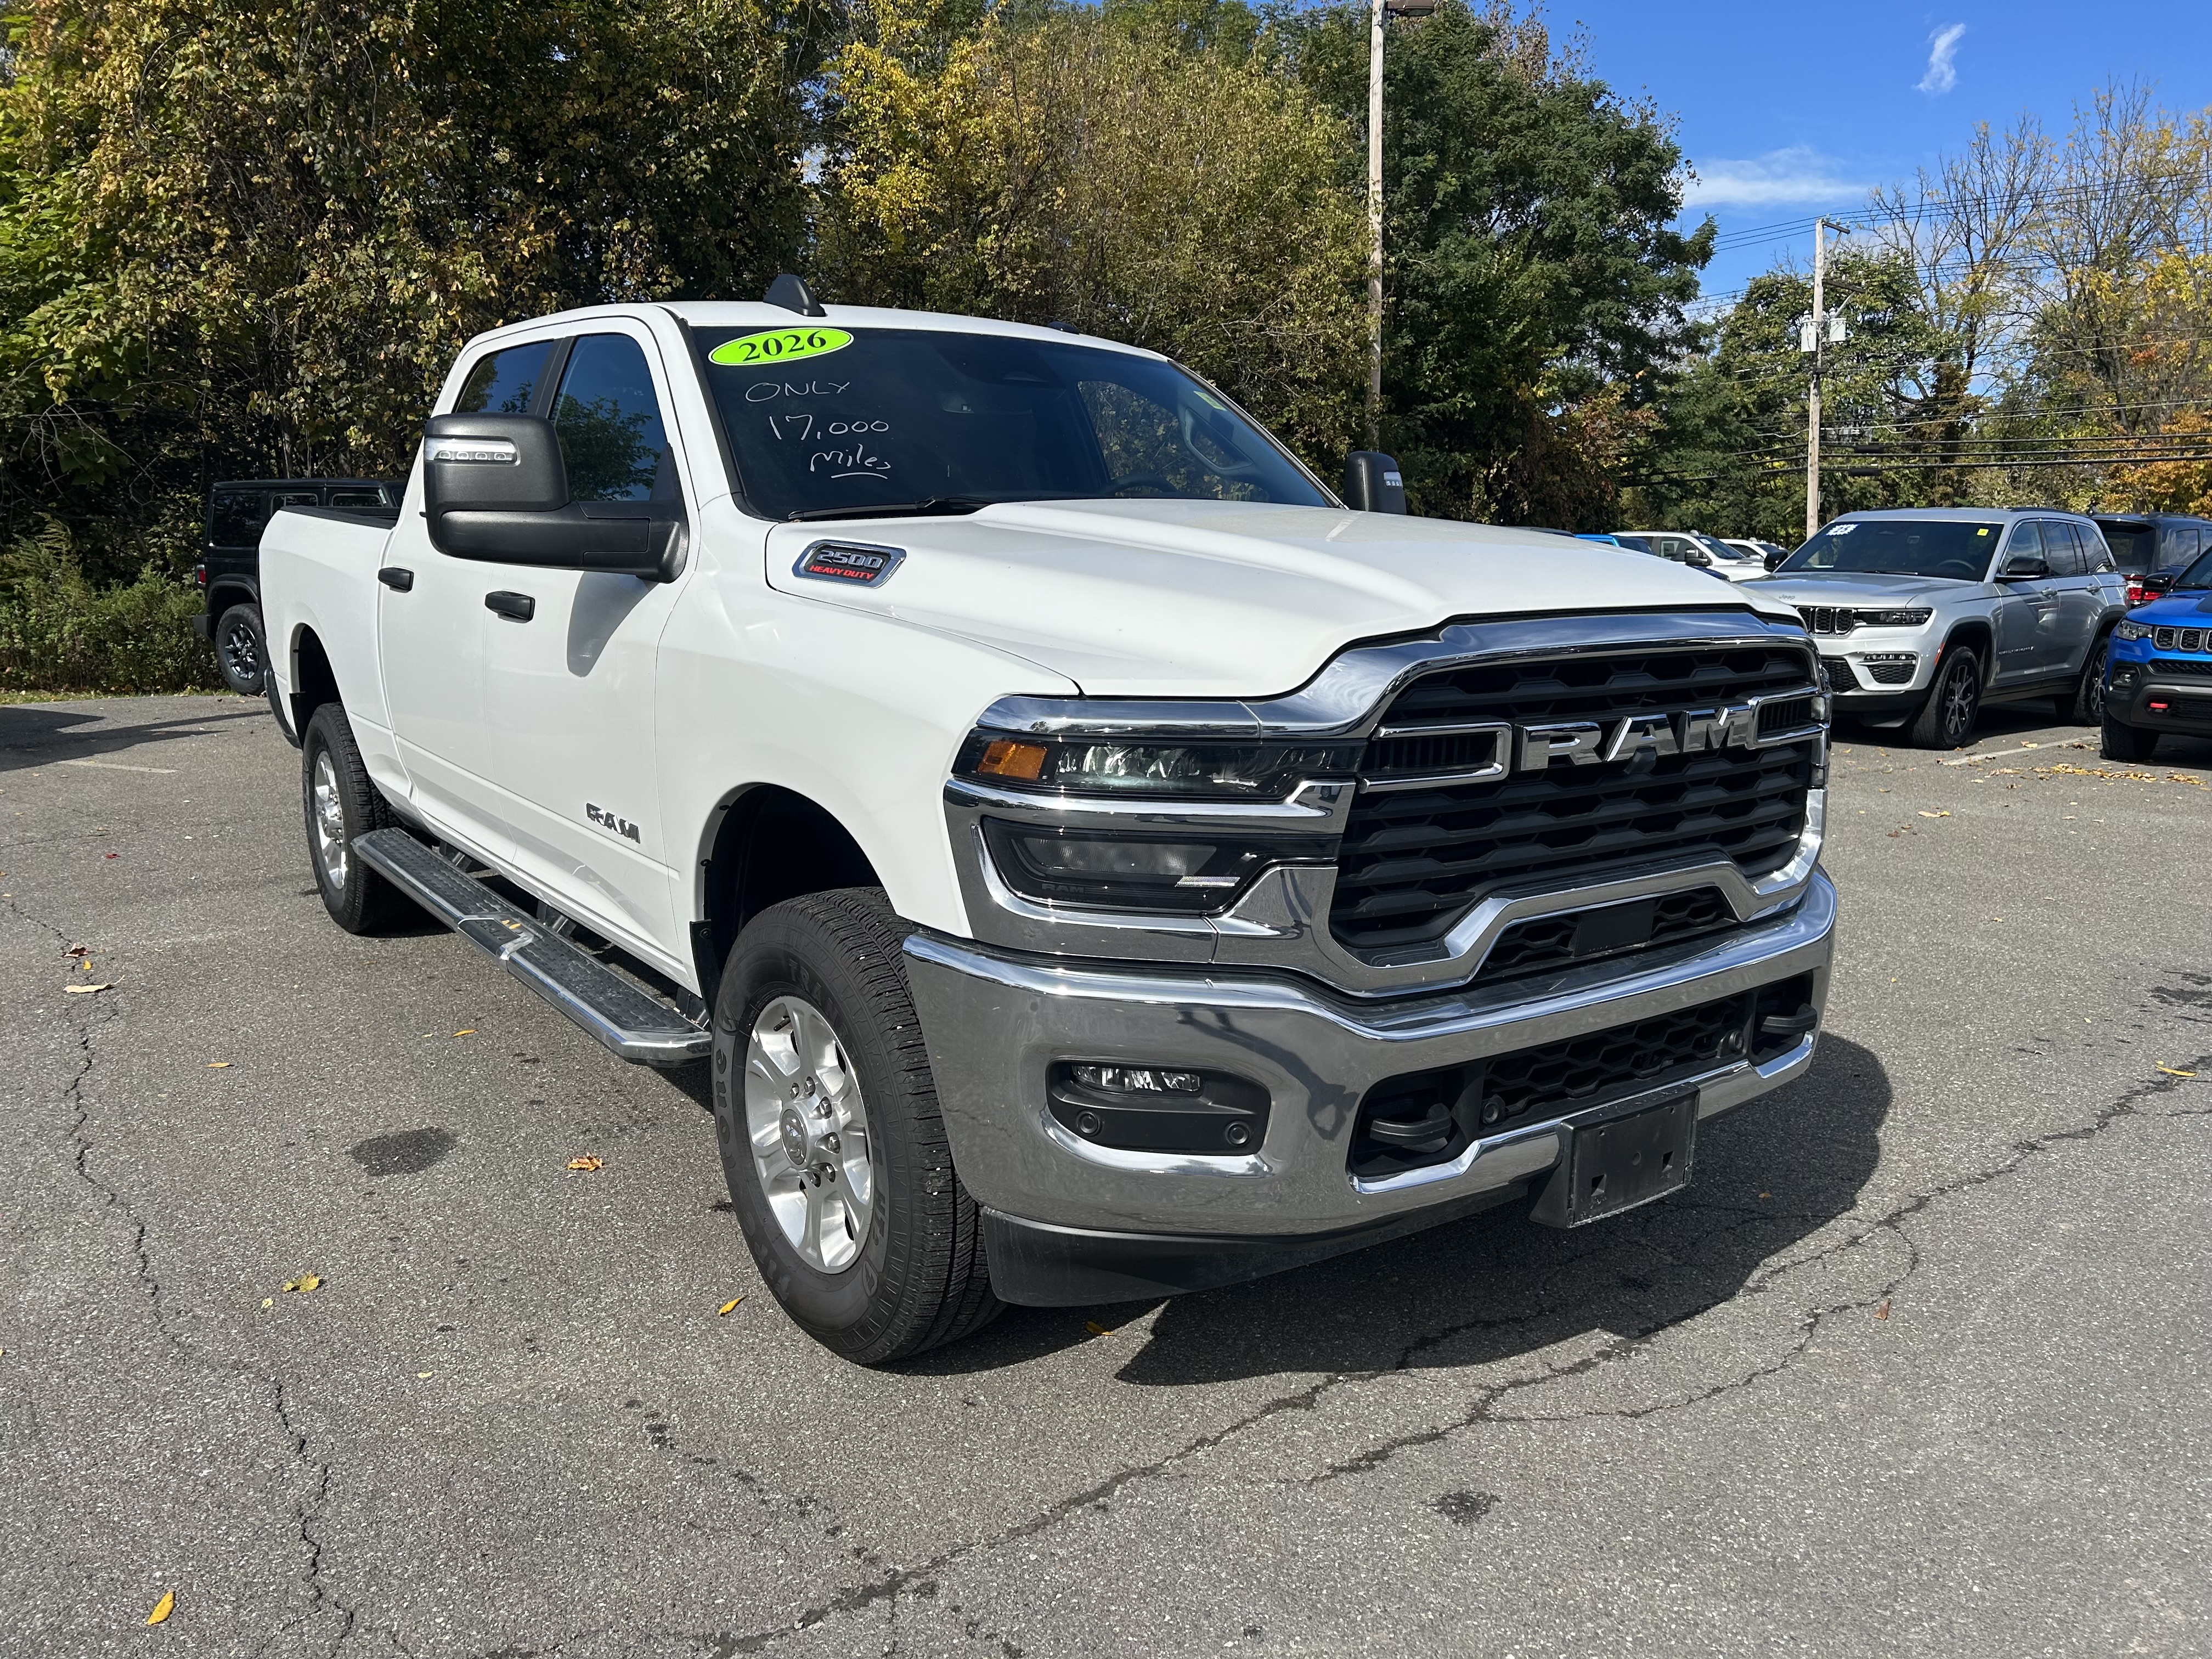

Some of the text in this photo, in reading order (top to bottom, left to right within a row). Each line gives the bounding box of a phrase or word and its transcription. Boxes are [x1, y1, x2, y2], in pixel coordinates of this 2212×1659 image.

[738, 330, 826, 362] 2026
[745, 381, 850, 402] ONLY
[769, 414, 889, 440] 17,000
[816, 549, 884, 570] 2500
[809, 565, 875, 580] HEAVY DUTY
[1516, 706, 1751, 771] RAM
[586, 803, 641, 844] RAM
[1042, 883, 1085, 894] RAM
